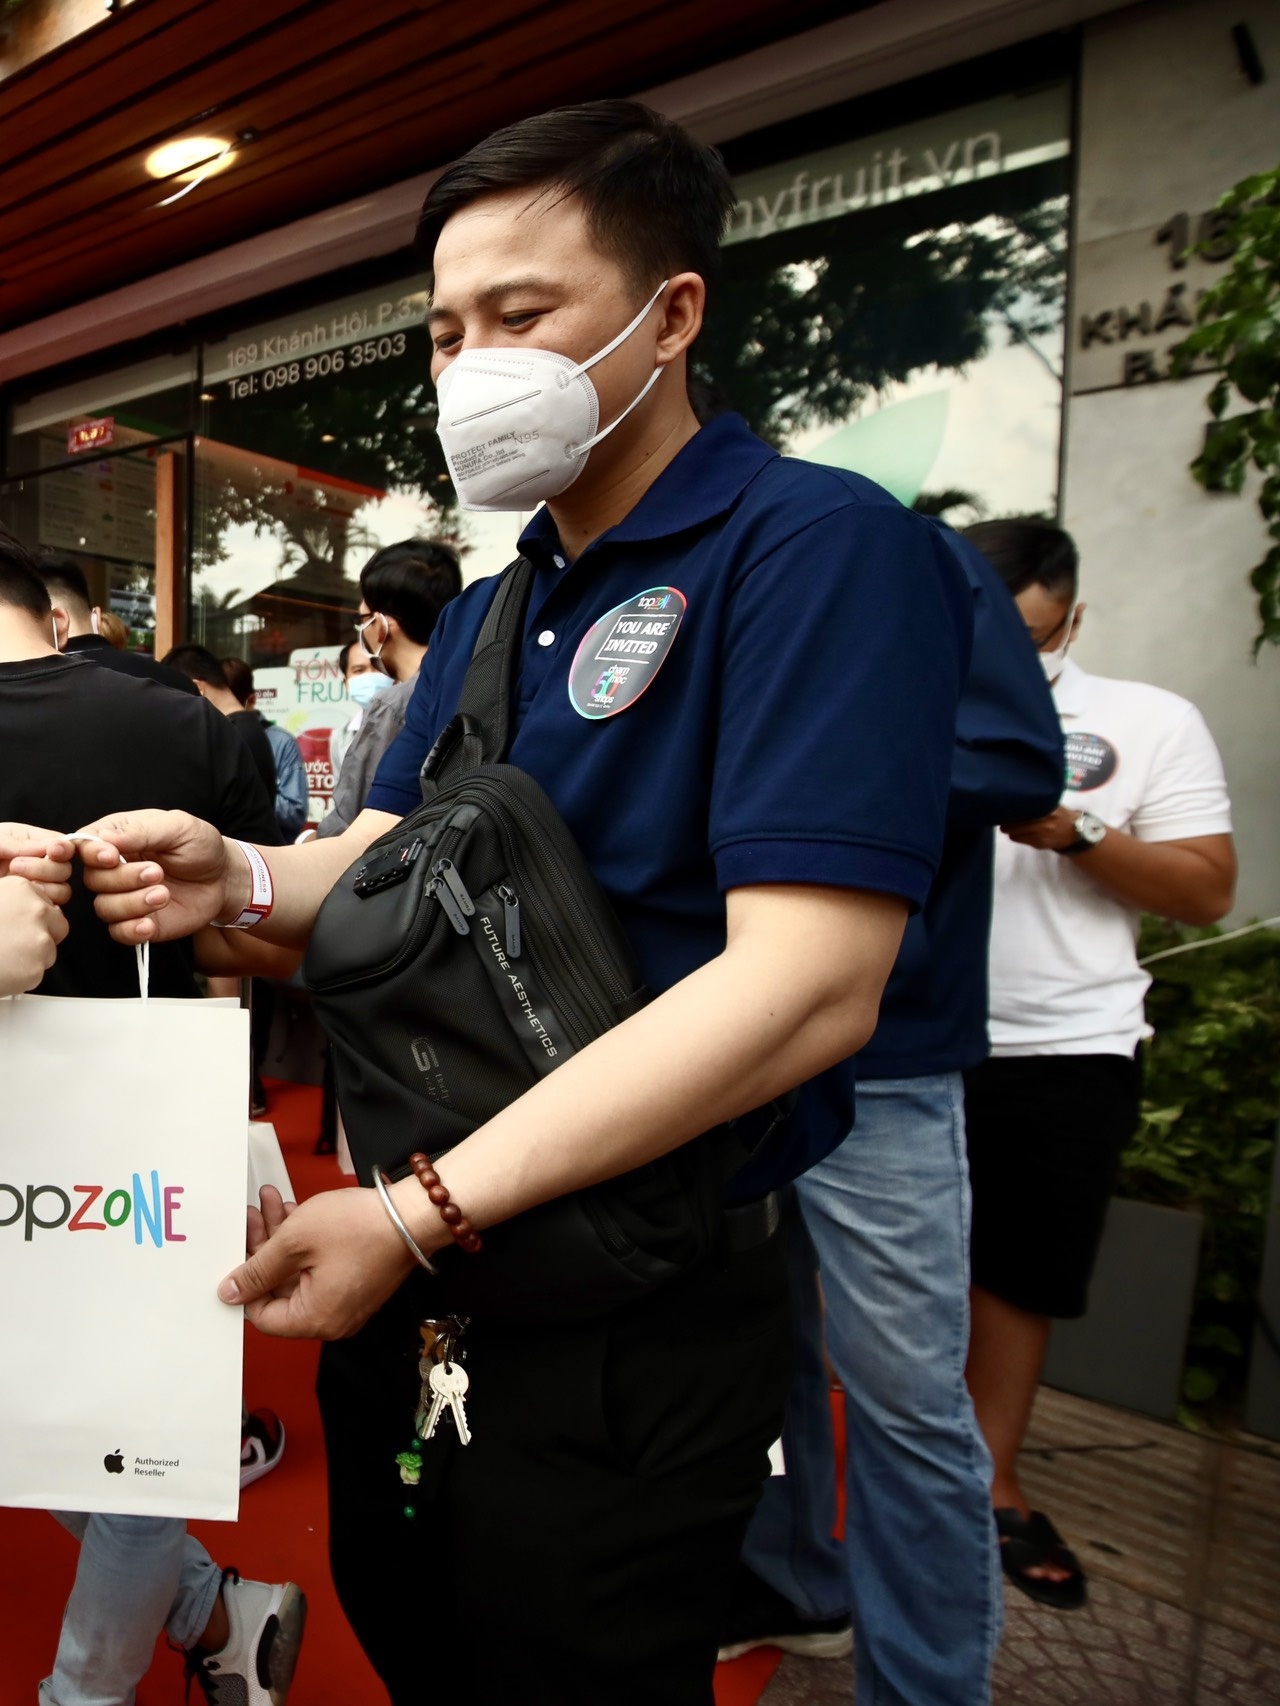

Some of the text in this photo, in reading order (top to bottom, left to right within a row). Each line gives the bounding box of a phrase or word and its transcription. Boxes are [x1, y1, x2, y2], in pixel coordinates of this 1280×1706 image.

[227, 343, 258, 368] 169
[263, 326, 327, 359] Khánh
[229, 333, 407, 400] Tel: 098 906 3503
[514, 430, 540, 445] N95
[450, 443, 486, 461] PROTECT
[488, 431, 516, 447] FAMILY
[453, 453, 477, 466] Product
[615, 621, 671, 636] YOU ARE
[604, 639, 658, 655] INVITED
[294, 651, 340, 684] TÓN
[308, 774, 336, 789] ETO
[479, 916, 558, 1058] FUTURE AESTHETICS
[134, 1457, 180, 1467] Authorized
[134, 1467, 166, 1477] Reseller
